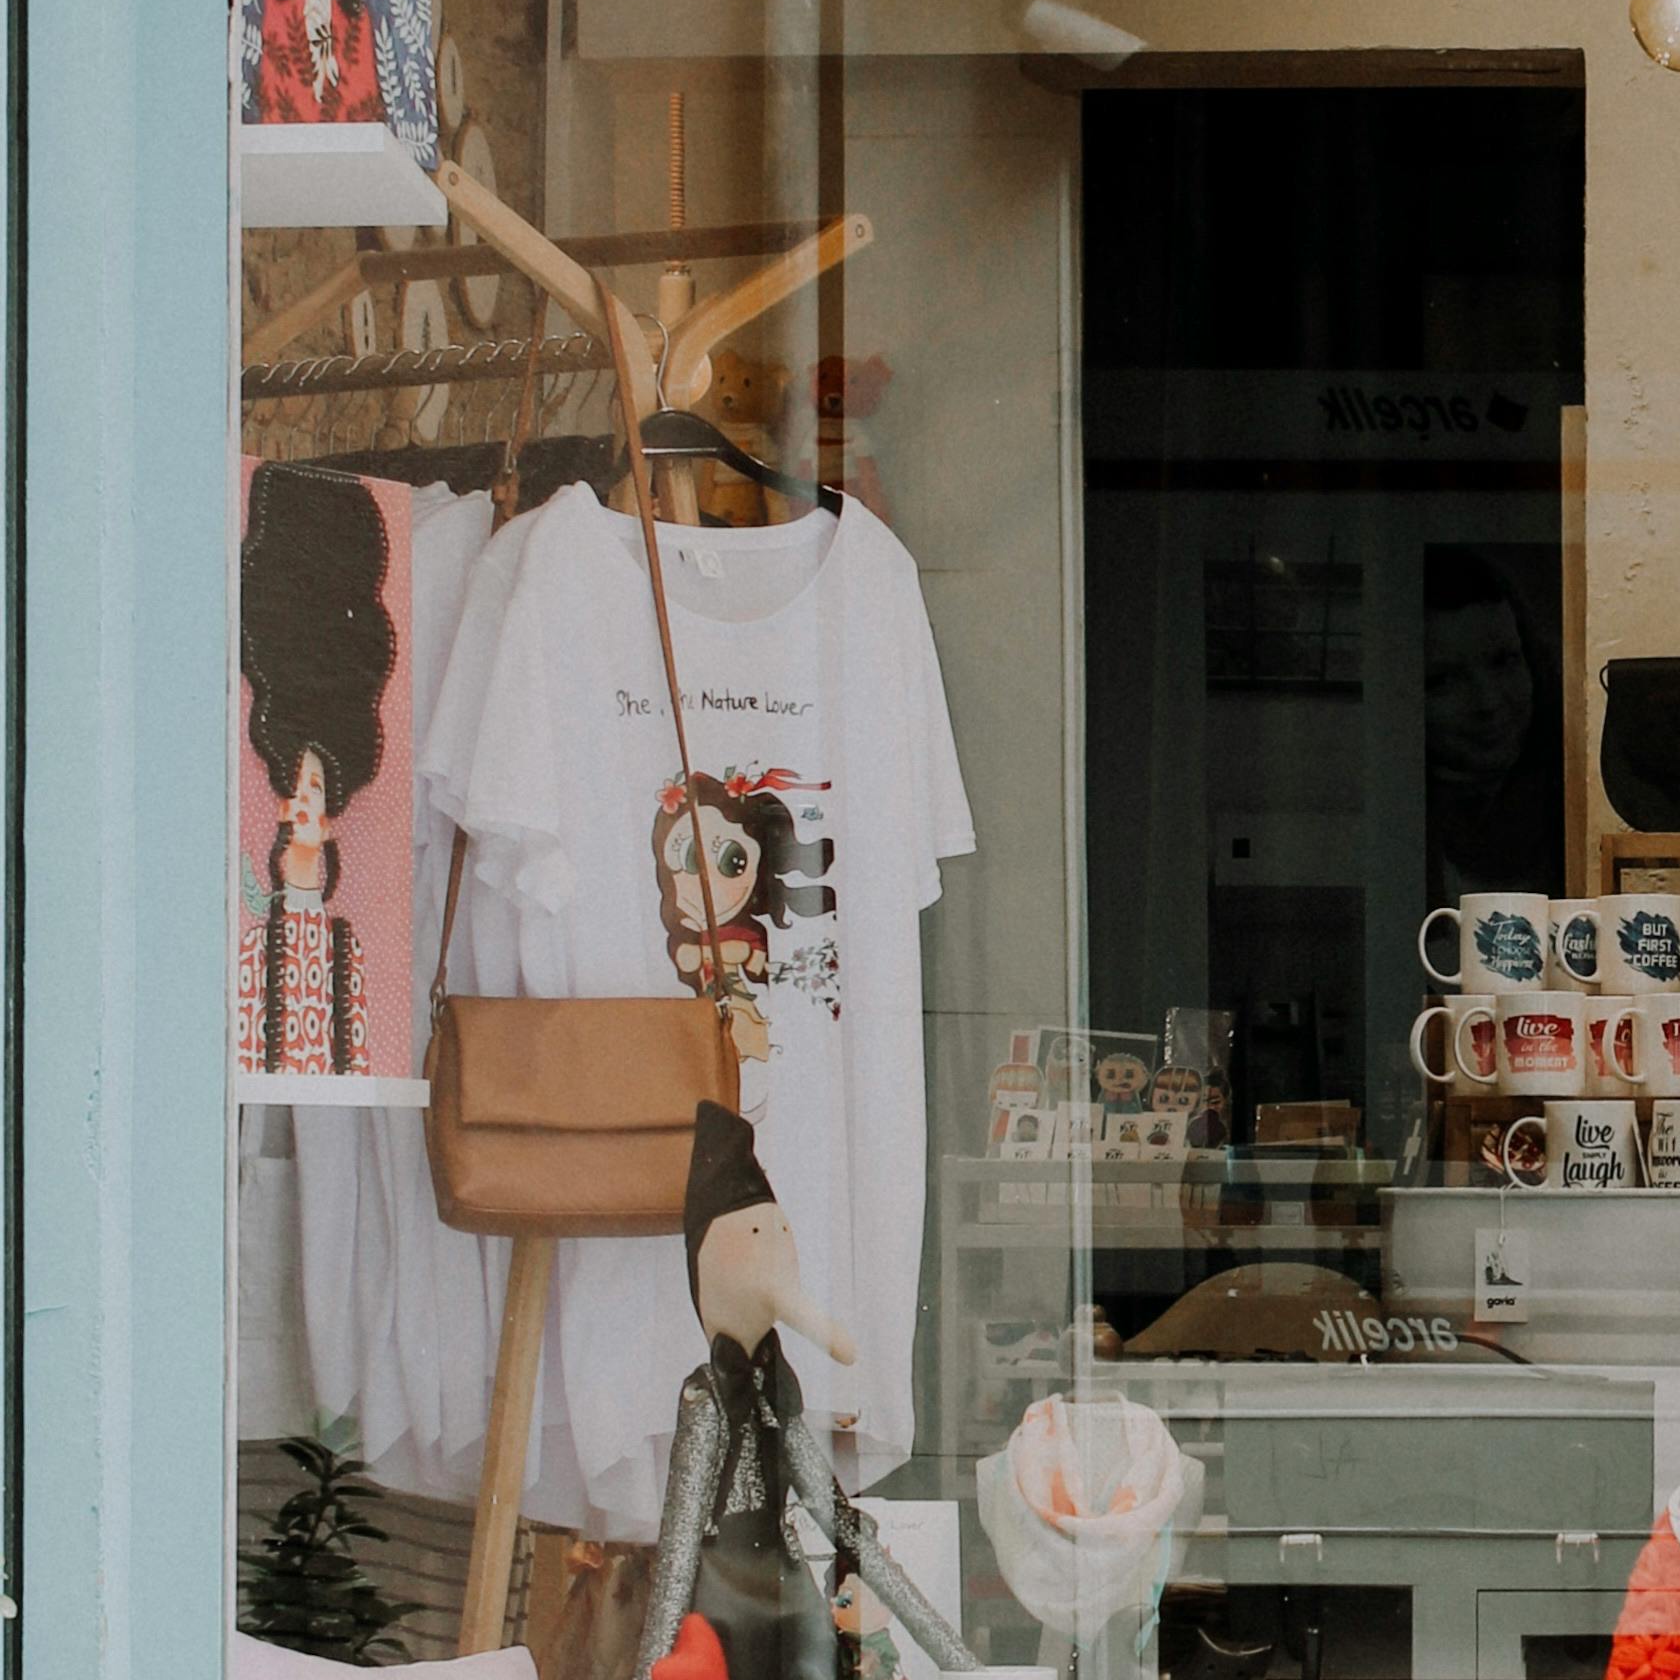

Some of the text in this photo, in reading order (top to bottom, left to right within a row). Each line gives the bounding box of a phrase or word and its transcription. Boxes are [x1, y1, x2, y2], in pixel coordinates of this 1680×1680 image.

[701, 688, 759, 711] Nature
[764, 691, 814, 716] Lover
[1641, 922, 1668, 936] BUT
[1637, 939, 1673, 953] FIRST
[1632, 954, 1678, 969] COFFEE
[1515, 1016, 1560, 1039] live
[1514, 1056, 1568, 1068] MOMENT
[1575, 1115, 1616, 1150] live
[1563, 1152, 1625, 1187] laugh
